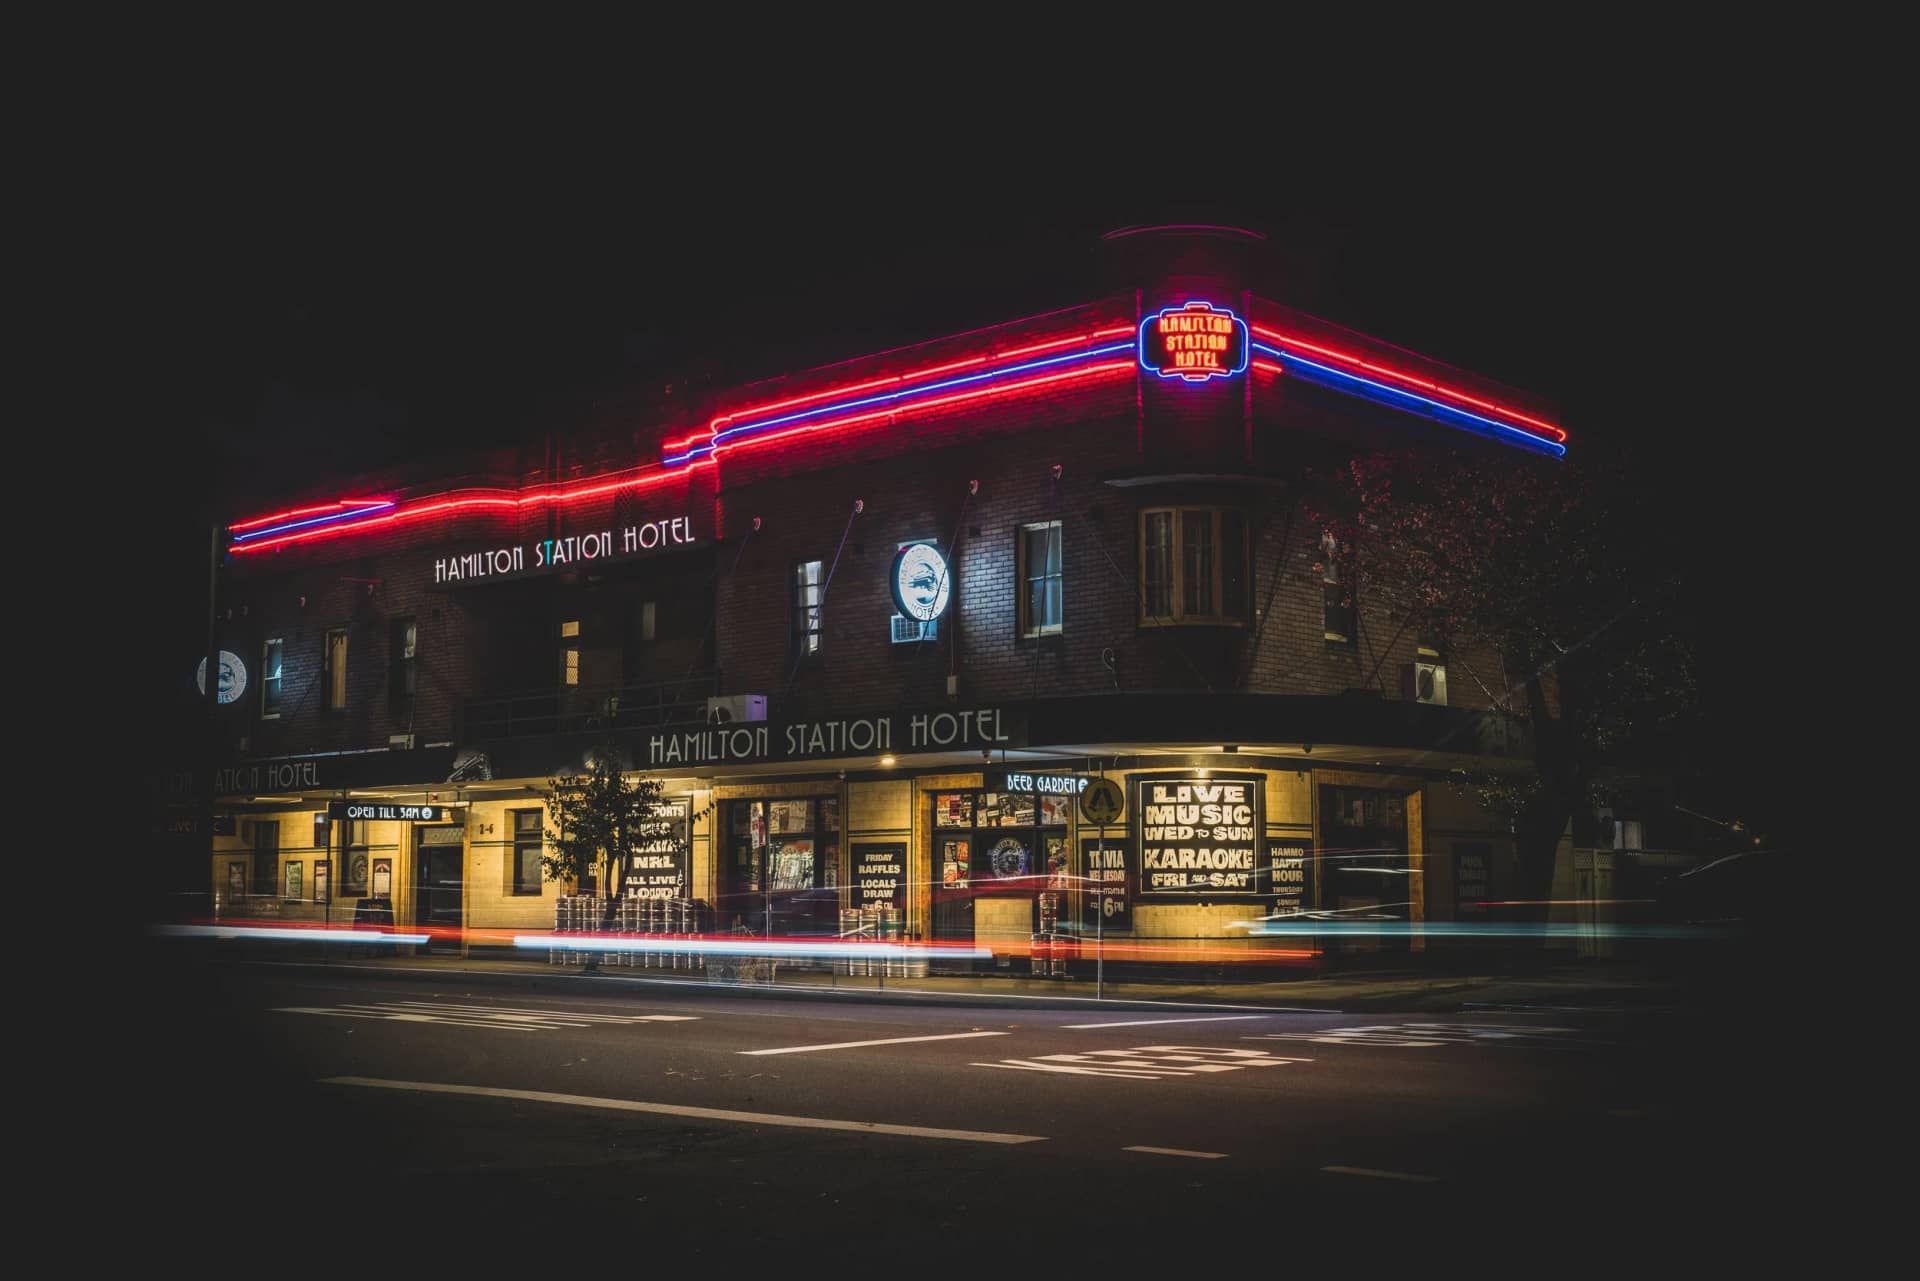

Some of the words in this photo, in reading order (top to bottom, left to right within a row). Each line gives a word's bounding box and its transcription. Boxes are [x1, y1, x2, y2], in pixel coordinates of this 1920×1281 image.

[1160, 317, 1232, 333] HAMILTON
[1166, 334, 1227, 350] STATION
[1175, 351, 1218, 367] HOTEL
[435, 547, 523, 583] HAMILTON
[536, 531, 612, 567] STATION
[624, 516, 695, 552] HOTEL
[649, 727, 768, 764] HAMILTON
[786, 717, 890, 754] STATION
[911, 709, 1009, 746] HOTEL
[268, 762, 320, 789] HOTEL
[1007, 774, 1033, 791] BEER
[1037, 776, 1076, 793] GARDEN
[1153, 785, 1245, 803] LIVE
[347, 806, 375, 818] OPEN
[378, 807, 396, 819] TILL
[400, 807, 419, 819] 3AM
[1145, 804, 1251, 825] MUSIC
[1144, 826, 1194, 841] WED
[1212, 826, 1254, 841] SUN
[865, 853, 893, 862] FRIDAY
[1144, 848, 1253, 869] KARAOKE
[1271, 847, 1304, 857] HAMMO
[633, 855, 674, 869] NRL
[858, 864, 901, 874] RAFFLES
[1272, 858, 1303, 869] HAPPY
[625, 876, 646, 885] ALL
[649, 875, 676, 885] LIVE
[1151, 873, 1187, 887] FRI
[1209, 872, 1249, 887] SAT
[1272, 870, 1303, 882] HOUR
[860, 879, 896, 889] LOCALS
[863, 889, 894, 898] DRAW
